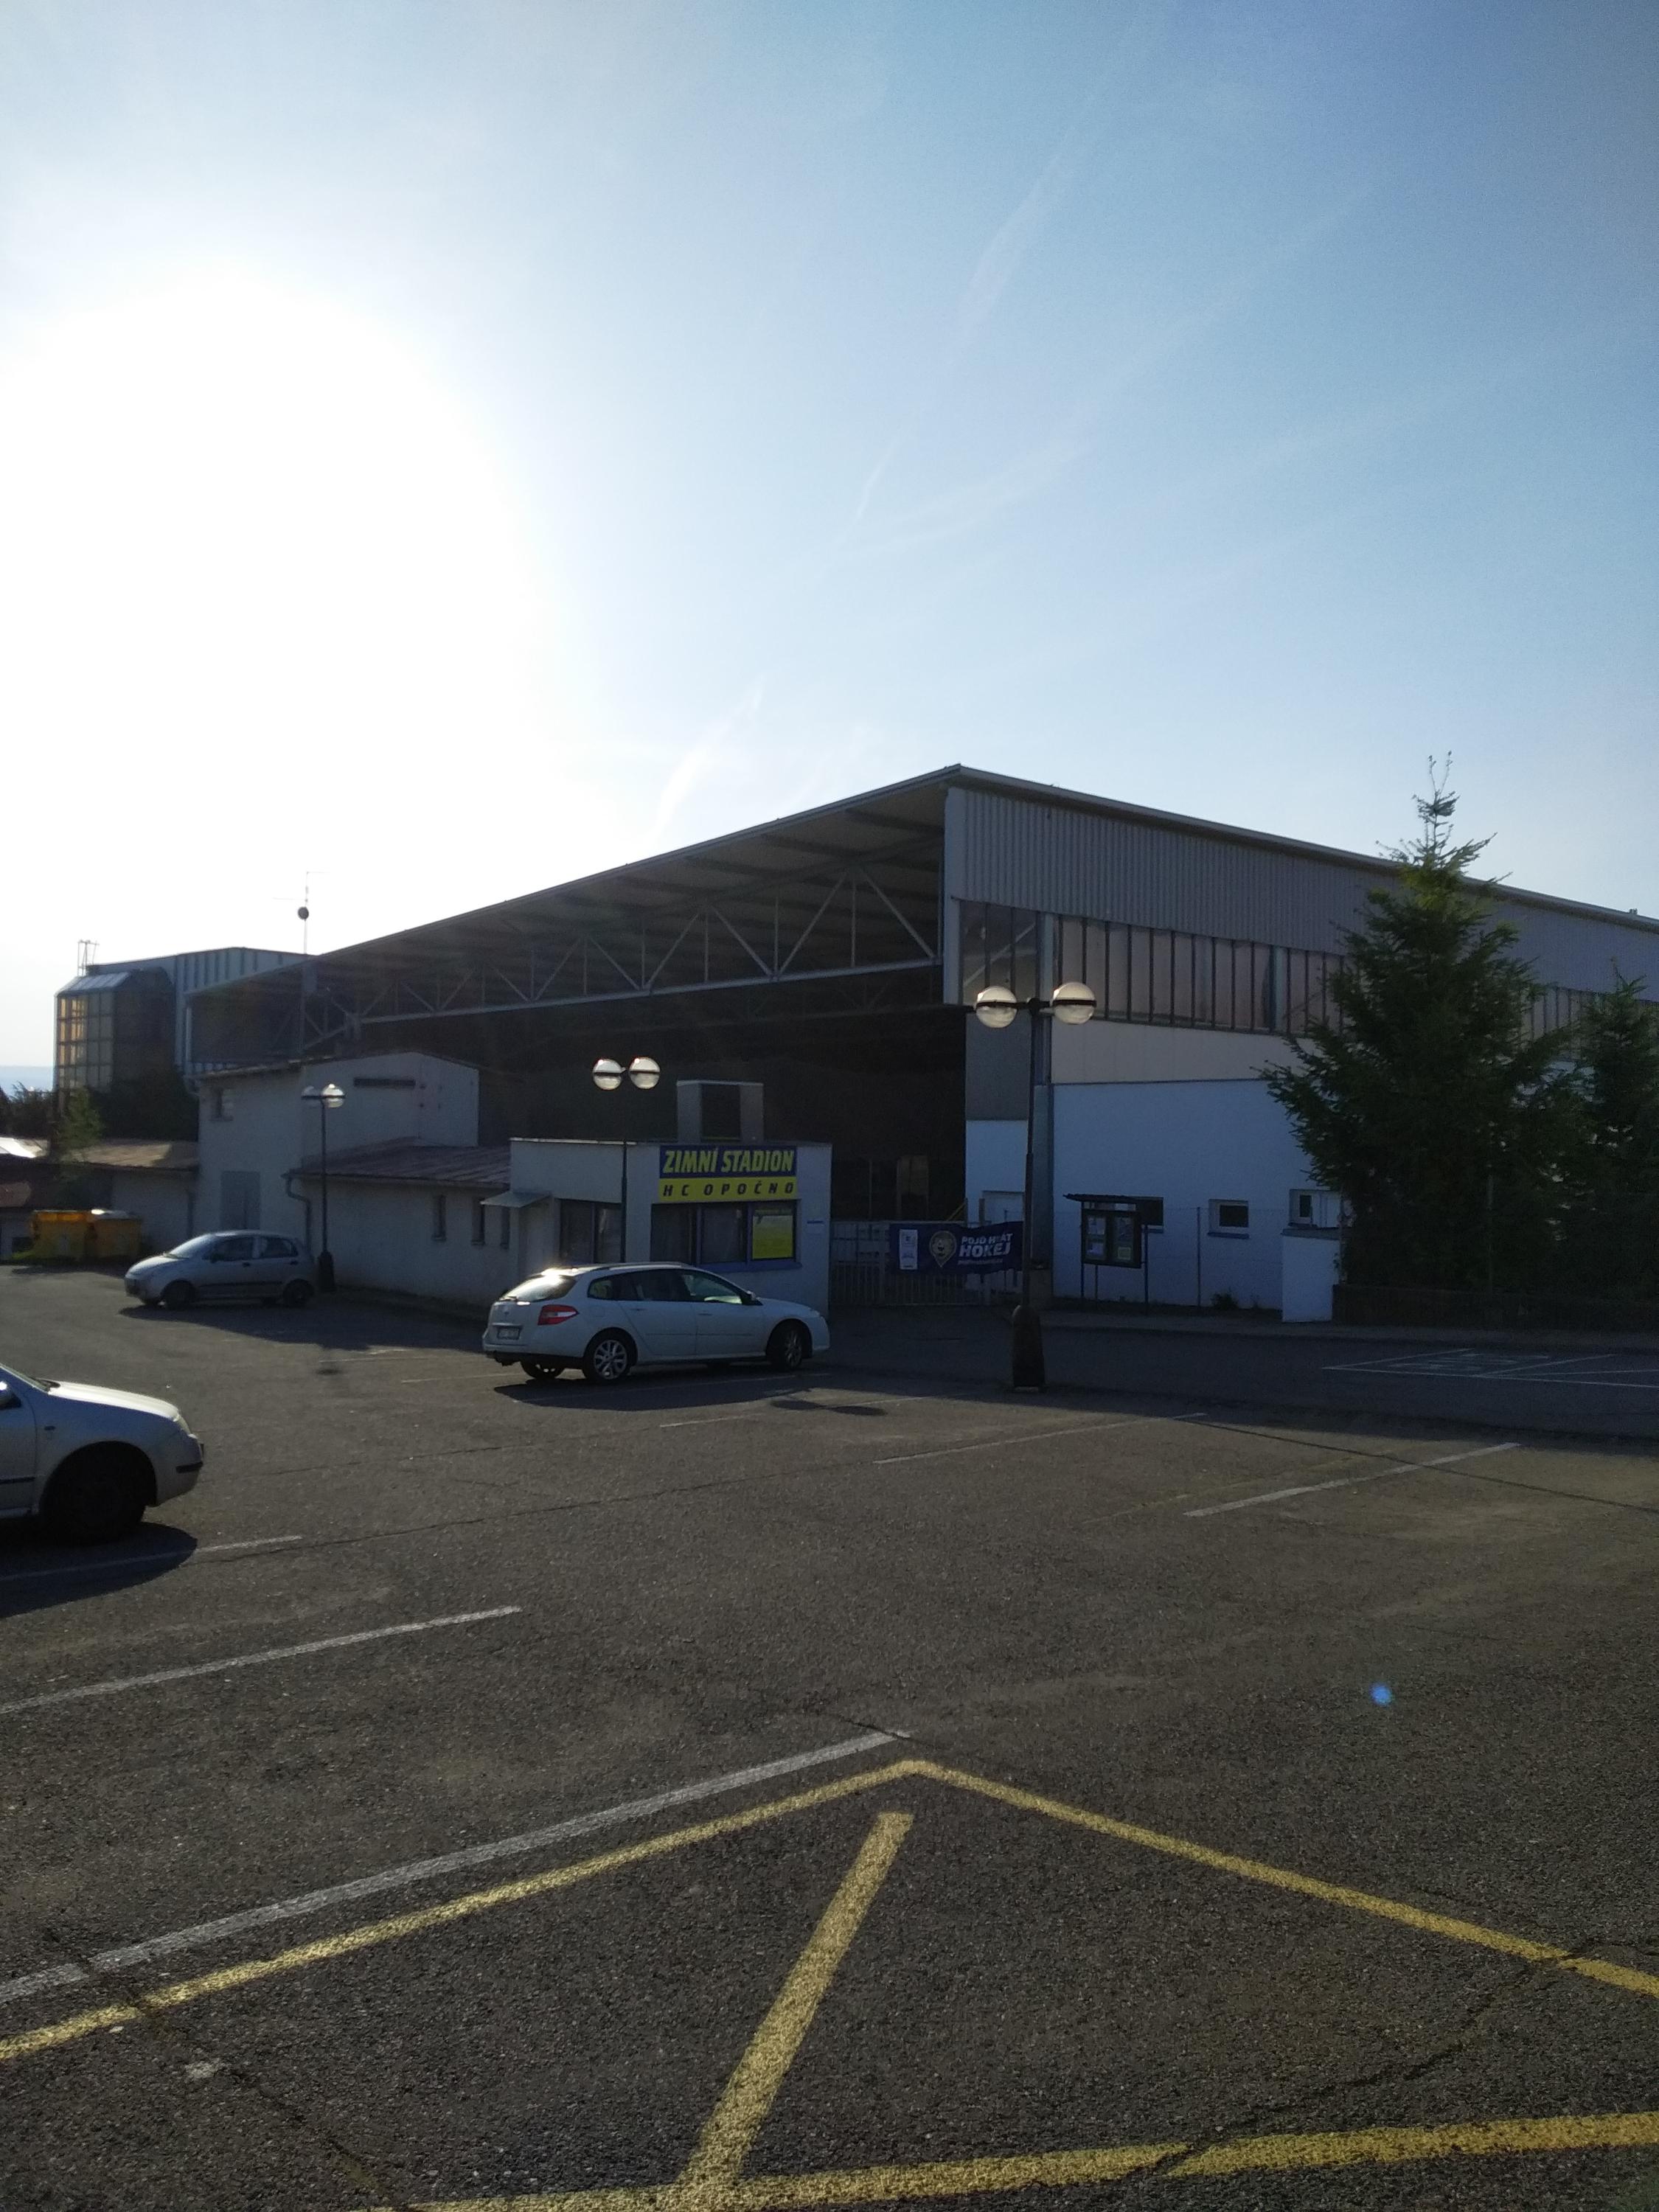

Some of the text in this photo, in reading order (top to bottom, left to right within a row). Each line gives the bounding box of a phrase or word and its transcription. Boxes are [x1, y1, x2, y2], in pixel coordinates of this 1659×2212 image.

[663, 1147, 795, 1174] ZIMNÍ STADION
[664, 1180, 794, 1197] HC OPOČNO
[959, 1242, 1011, 1257] HOKEJ
